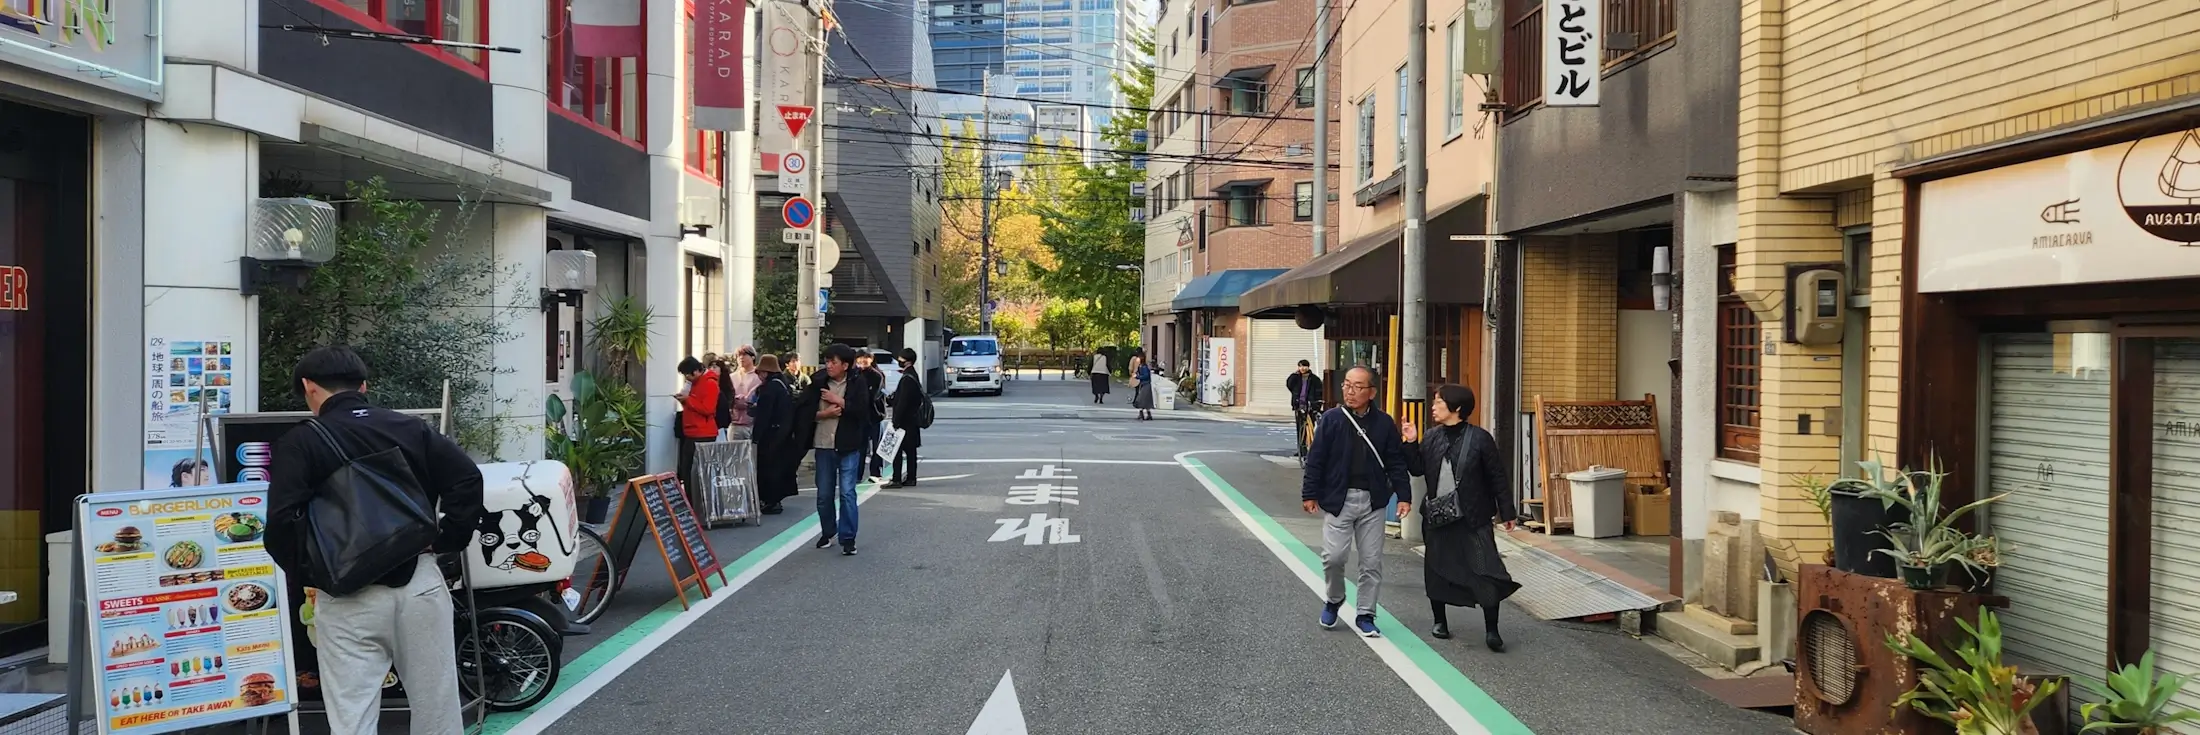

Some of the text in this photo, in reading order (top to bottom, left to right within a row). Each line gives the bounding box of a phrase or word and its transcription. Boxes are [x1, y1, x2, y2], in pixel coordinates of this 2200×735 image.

[1555, 0, 1593, 98] とビル
[778, 66, 790, 131] KARD
[784, 110, 807, 120] 止まれ
[788, 157, 801, 169] 30
[785, 232, 812, 241] 自動車
[151, 352, 164, 422] 地球一周の船旅
[128, 498, 233, 516] BURGERLION
[987, 465, 1081, 545] 止まれ
[104, 596, 143, 610] SWEETS
[120, 700, 235, 726] EAT HERE OR TAKE AWAY
